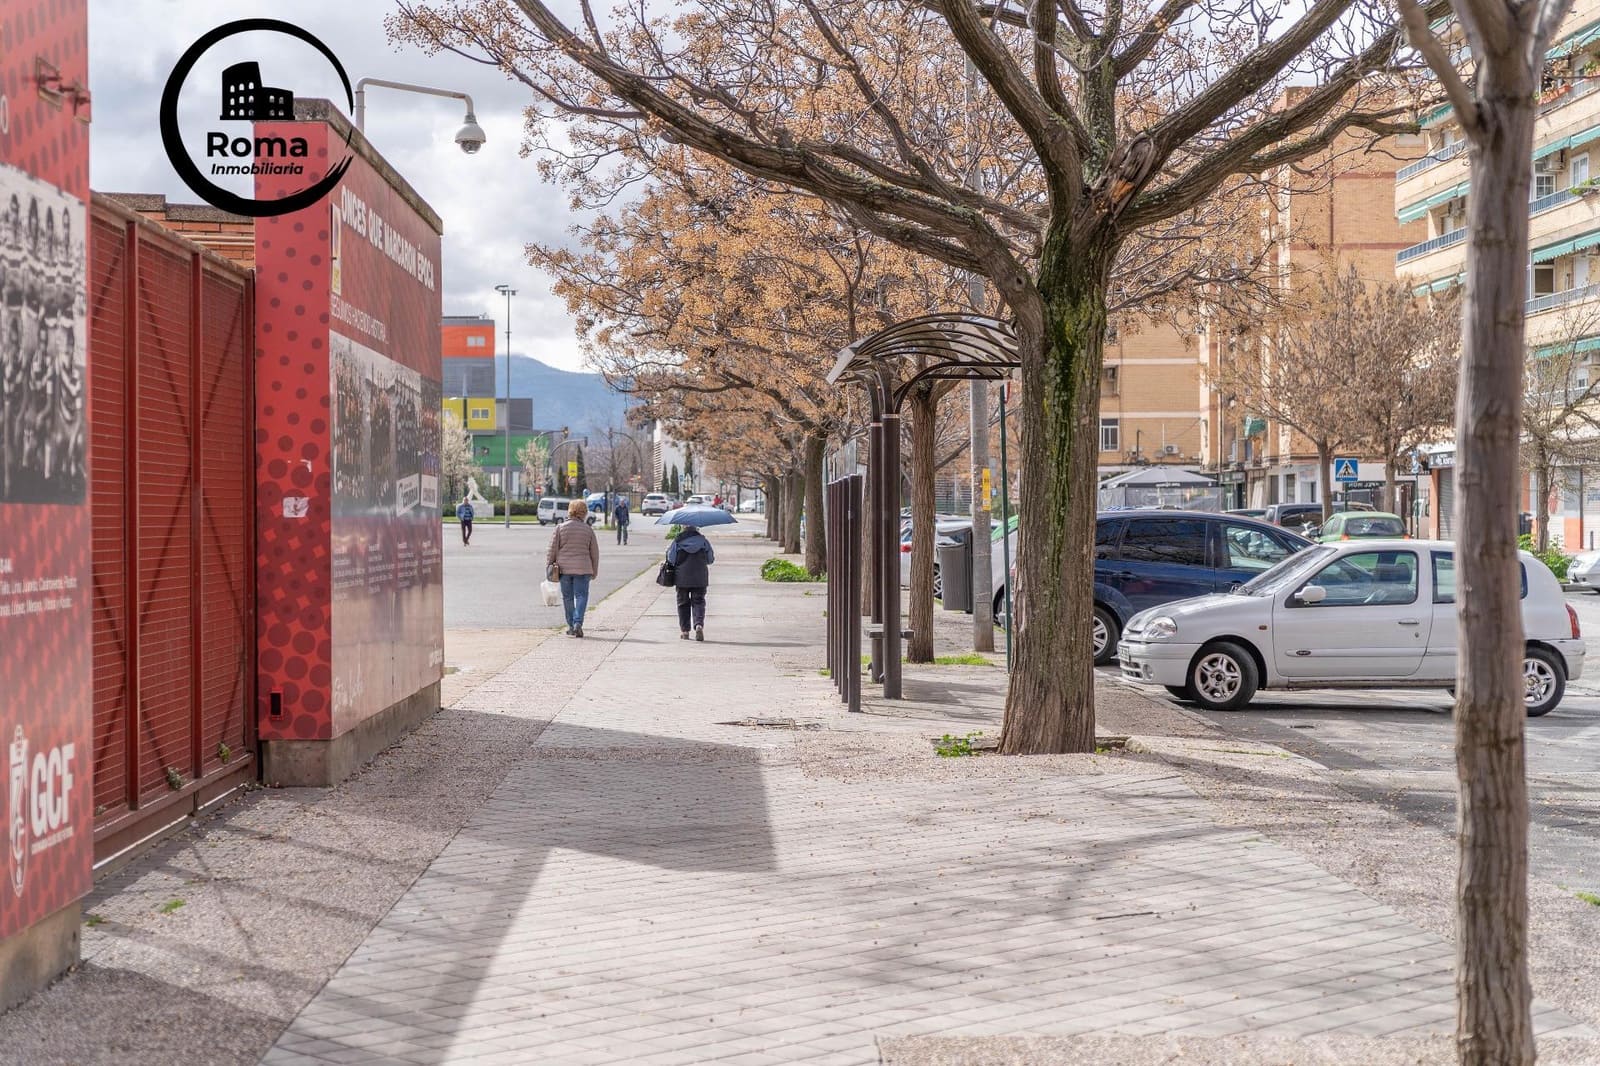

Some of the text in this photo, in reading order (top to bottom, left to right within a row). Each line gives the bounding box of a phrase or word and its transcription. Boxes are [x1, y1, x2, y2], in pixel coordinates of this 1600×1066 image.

[341, 184, 435, 292] ONCES QUE MARCARON ÉPOCA
[31, 742, 75, 838] GCF
